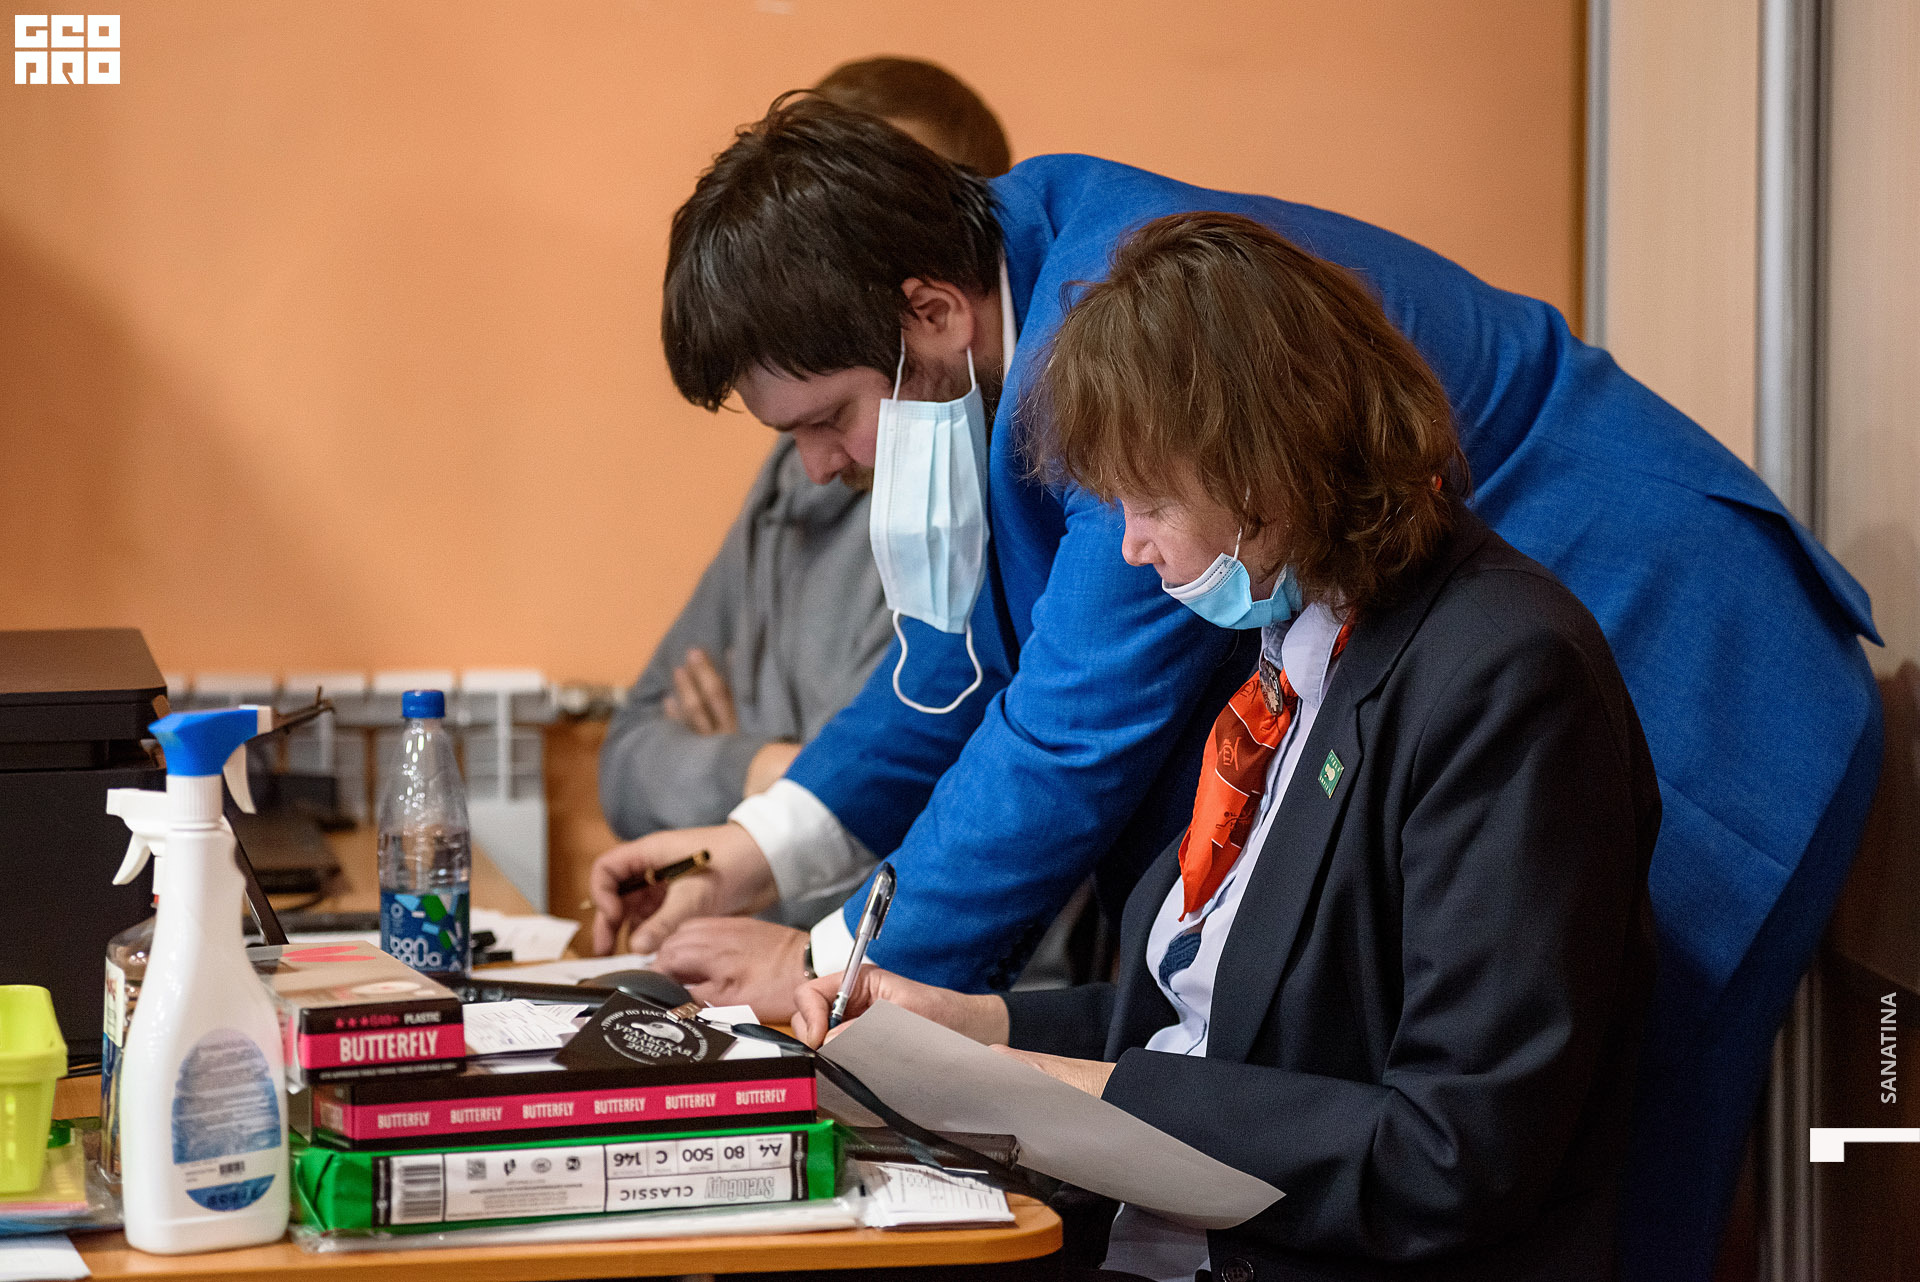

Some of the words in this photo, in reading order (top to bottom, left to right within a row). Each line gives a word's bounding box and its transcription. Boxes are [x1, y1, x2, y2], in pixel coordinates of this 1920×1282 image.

[340, 1030, 438, 1063] BUTTERFLY
[613, 1023, 692, 1057] УРАЛЬСКАЯ
[626, 1042, 661, 1058] 2020
[377, 1112, 431, 1129] BUTTERFLY
[450, 1106, 503, 1124] BUTTERFLY
[522, 1102, 575, 1119] BUTTERFLY
[594, 1097, 646, 1115] BUTTERFLY
[665, 1093, 717, 1110] BUTTERFLY
[735, 1089, 787, 1106] BUTTERFLY
[682, 1148, 714, 1162] 500
[723, 1146, 745, 1159] 80
[758, 1143, 782, 1157] A4
[613, 1152, 642, 1167] 146
[619, 1186, 694, 1201] CLASSIC
[704, 1176, 775, 1199] SvetoCopy
